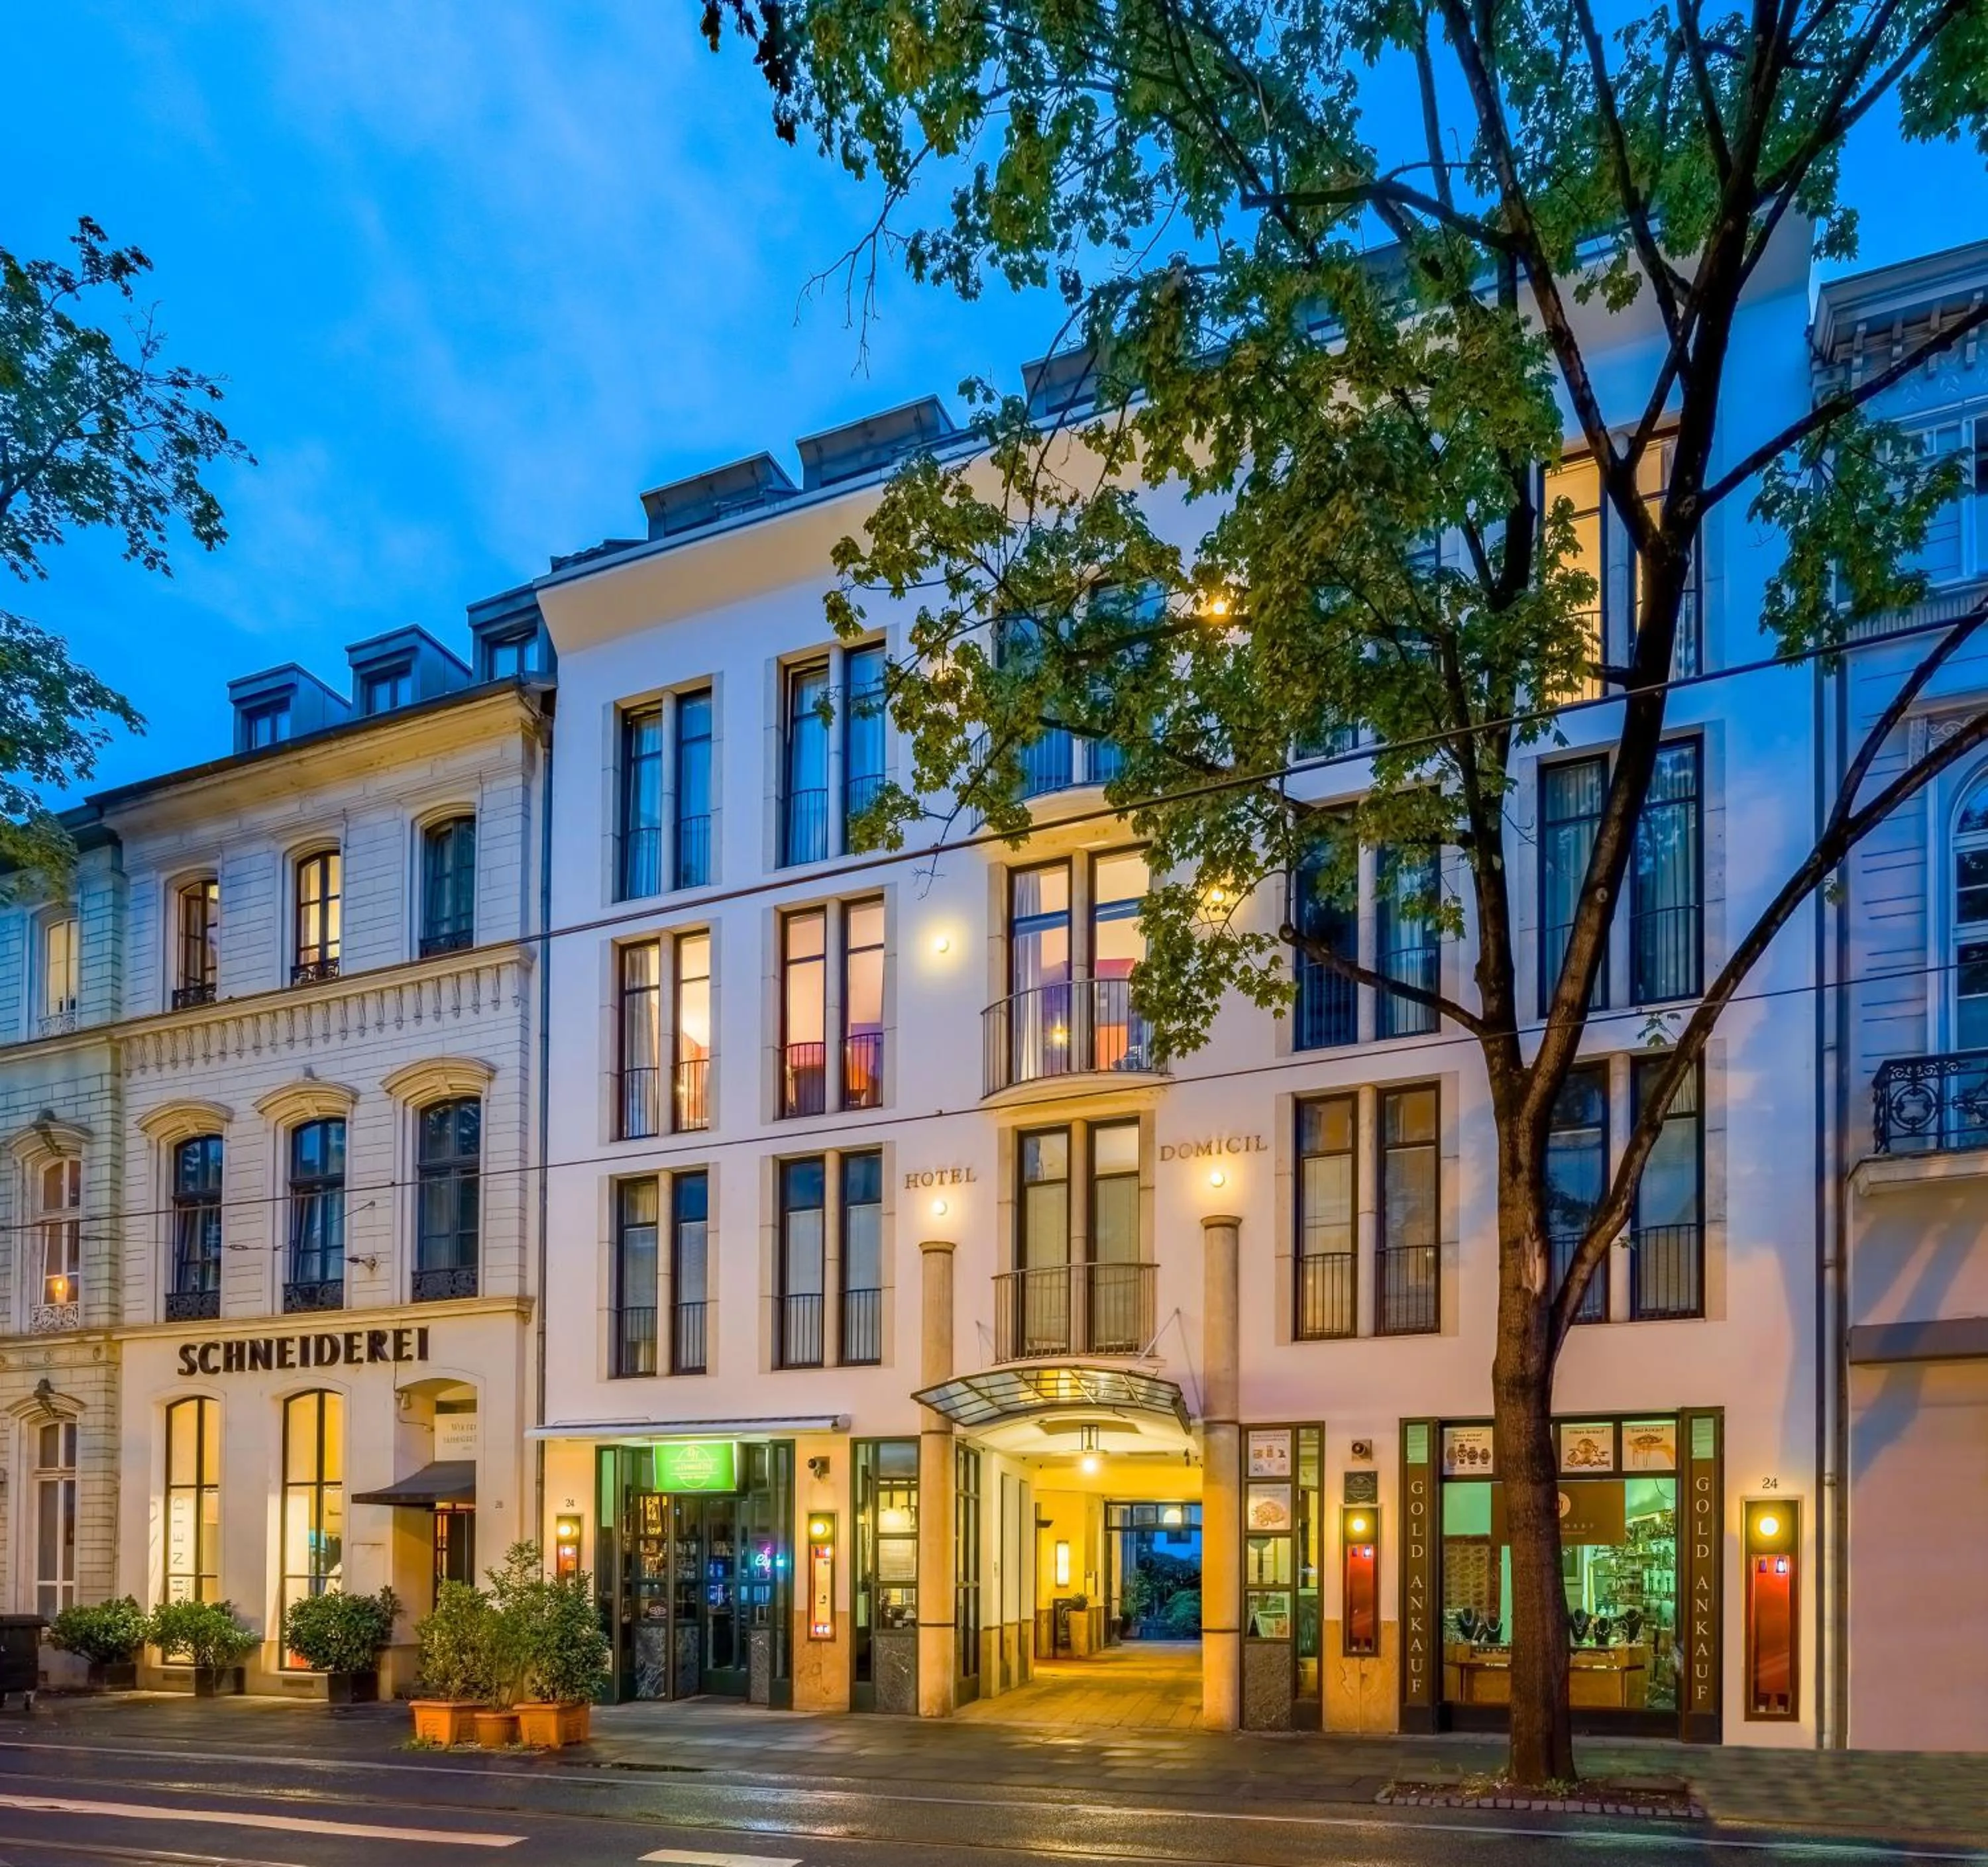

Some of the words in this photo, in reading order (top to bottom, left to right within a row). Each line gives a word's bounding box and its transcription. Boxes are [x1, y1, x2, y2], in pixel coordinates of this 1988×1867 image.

[904, 1167, 978, 1190] HOTEL
[1159, 1135, 1268, 1161] DOMICIL
[177, 1327, 429, 1377] SCHNEIDEREI
[565, 1498, 575, 1507] 24
[1762, 1477, 1777, 1489] 24
[1411, 1480, 1424, 1558] GOLD
[1696, 1476, 1710, 1558] GOLD
[1409, 1574, 1424, 1693] ANKAUF
[1695, 1575, 1709, 1700] ANKAUF
